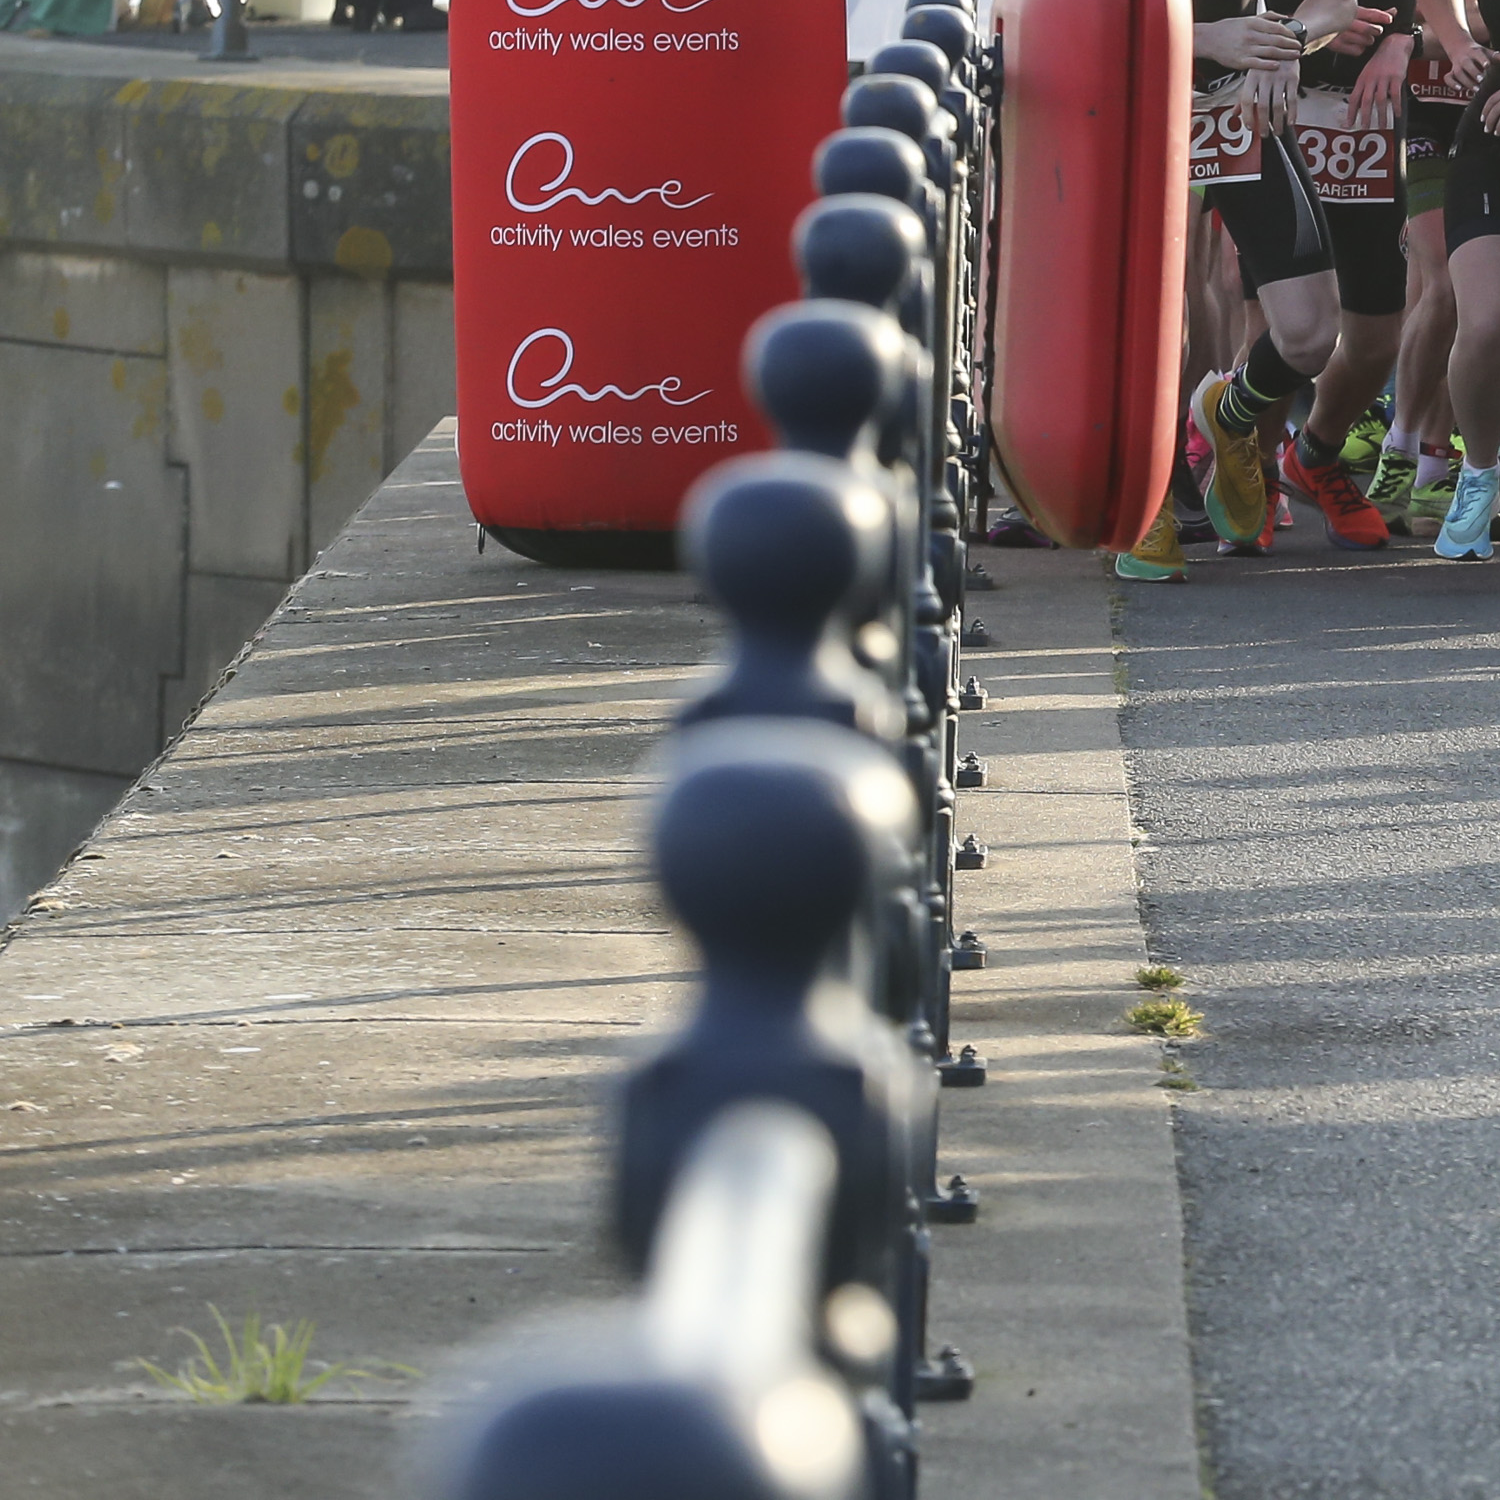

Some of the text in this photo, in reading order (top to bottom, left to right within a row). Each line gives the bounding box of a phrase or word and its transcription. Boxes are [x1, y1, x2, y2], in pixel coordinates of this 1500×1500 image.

[490, 28, 738, 55] activity wales events
[1297, 129, 1388, 181] 382
[491, 224, 738, 251] activity wales events
[492, 419, 737, 446] activity wales events
